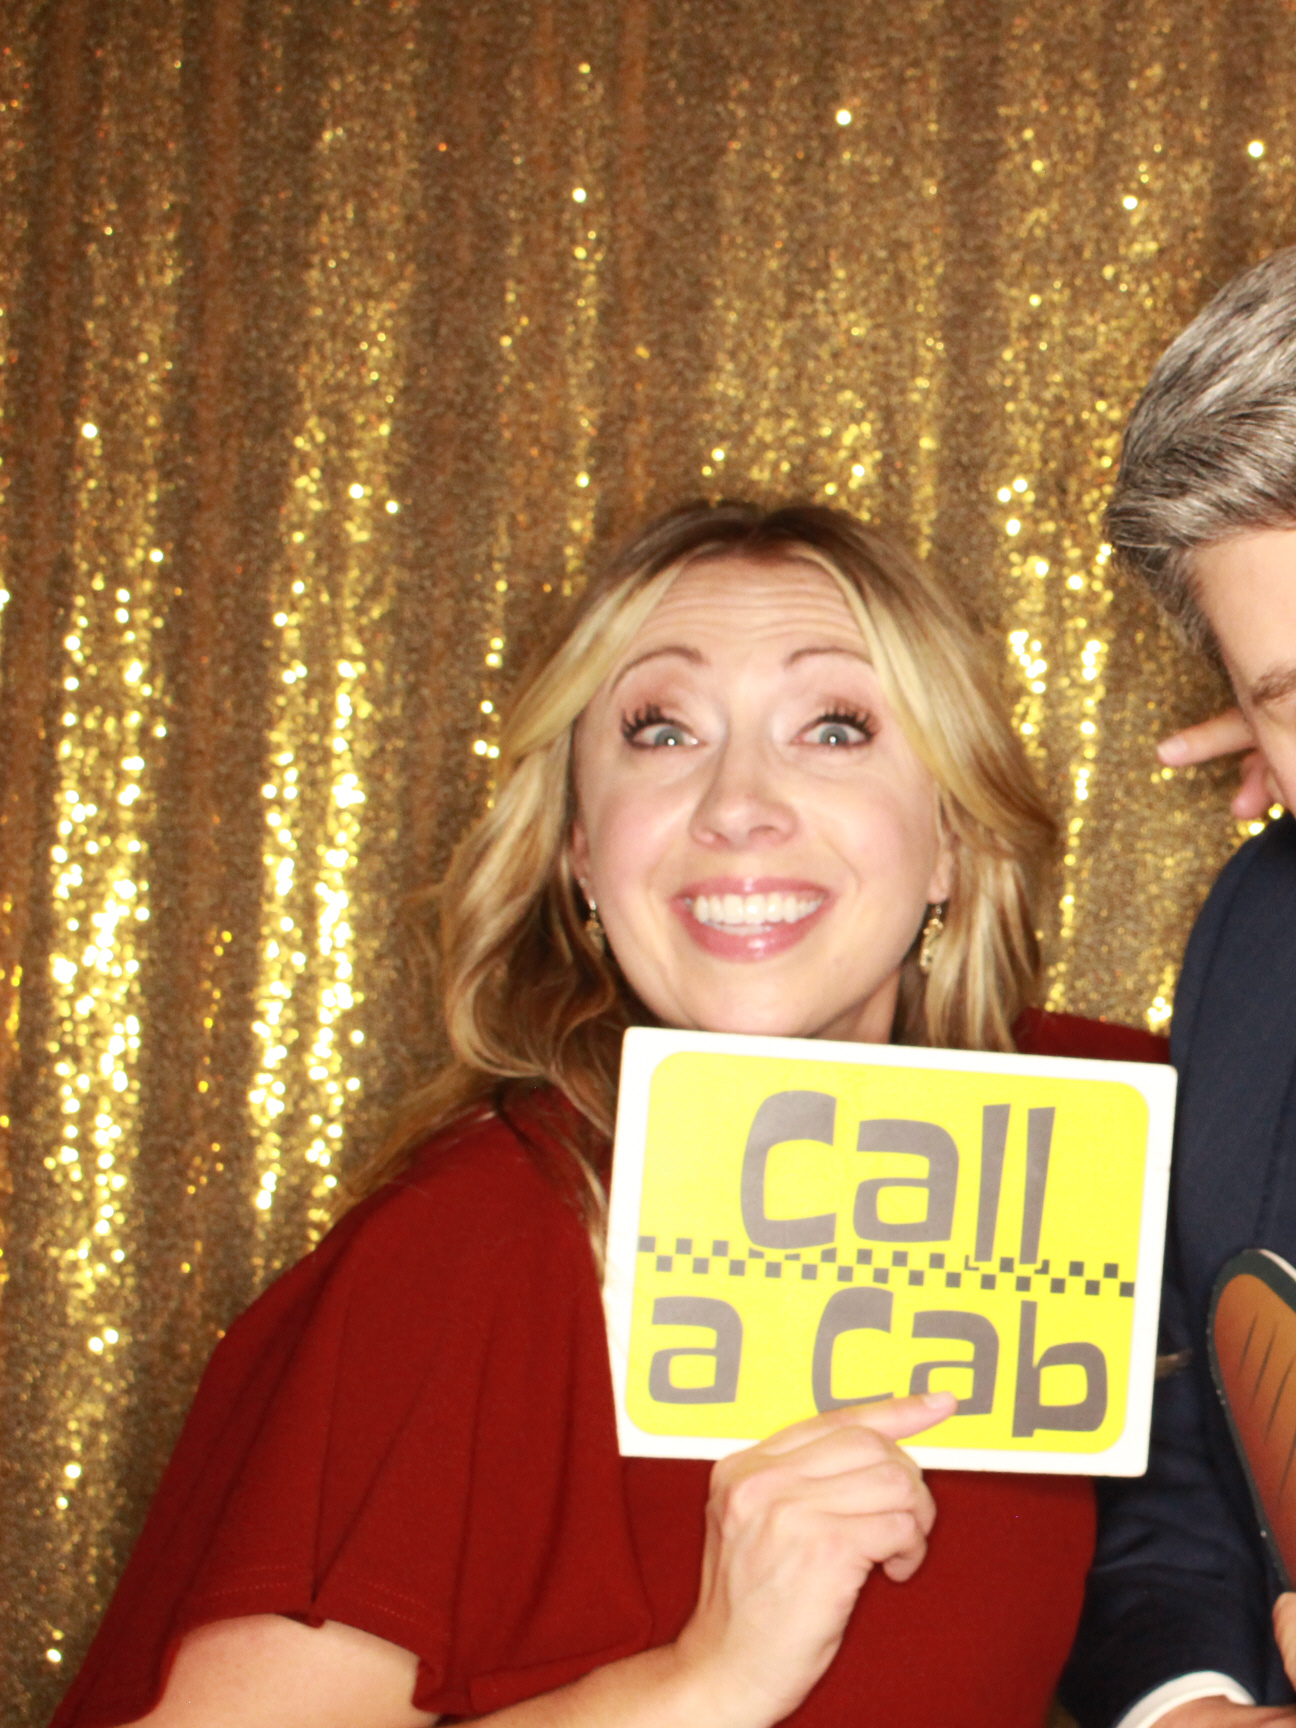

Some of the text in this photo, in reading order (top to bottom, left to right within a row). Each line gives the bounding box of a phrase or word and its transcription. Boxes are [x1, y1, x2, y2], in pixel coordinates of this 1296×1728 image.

[741, 1090, 1056, 1265] Call
[648, 1286, 1108, 1438] a Cab
